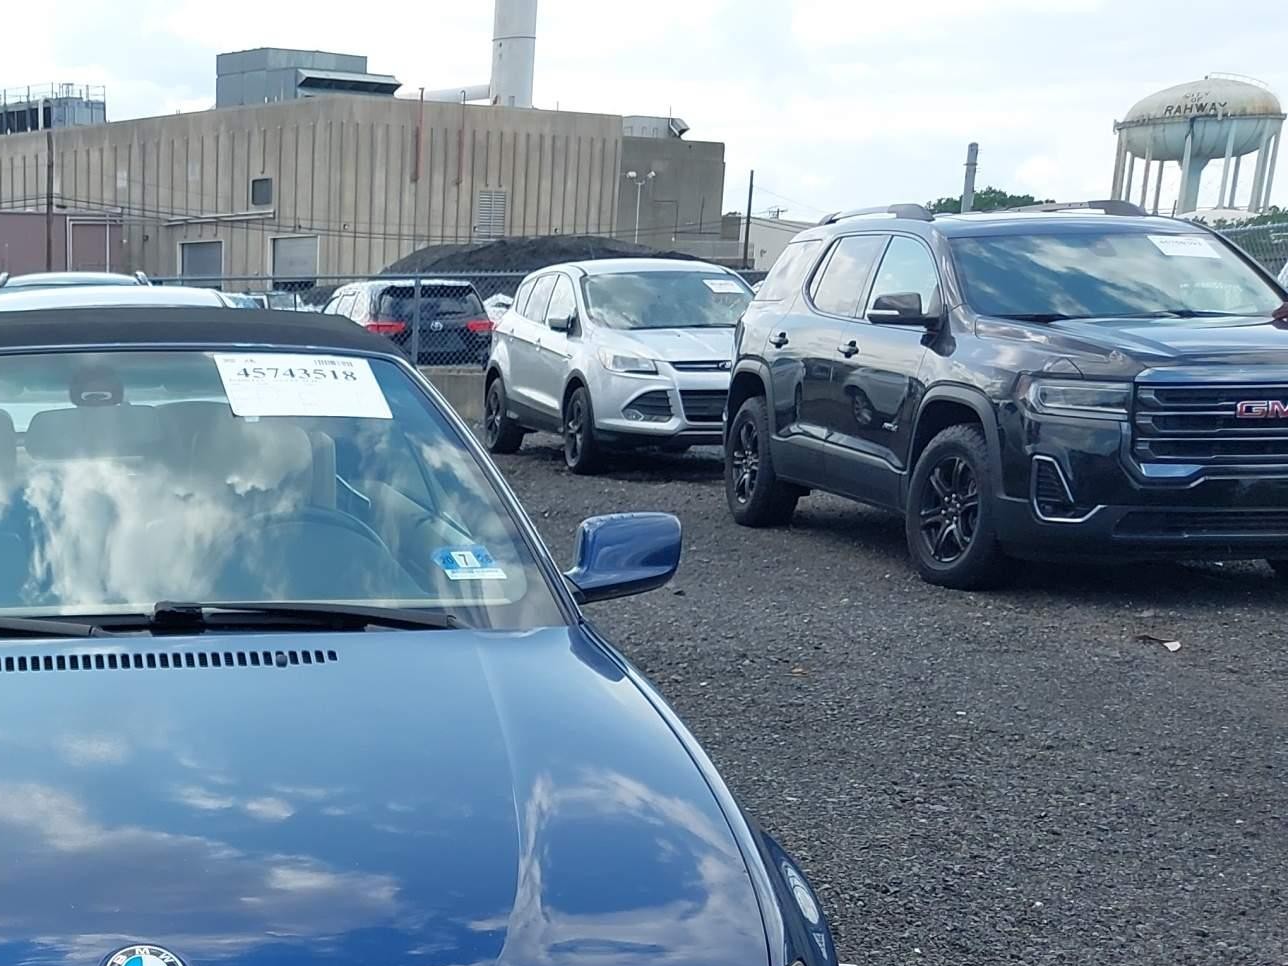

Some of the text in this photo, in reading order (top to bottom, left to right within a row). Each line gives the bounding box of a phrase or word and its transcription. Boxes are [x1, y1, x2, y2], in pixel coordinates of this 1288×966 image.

[1164, 102, 1228, 116] RAHWAY
[236, 367, 358, 381] 45743518
[113, 948, 174, 964] BMW
